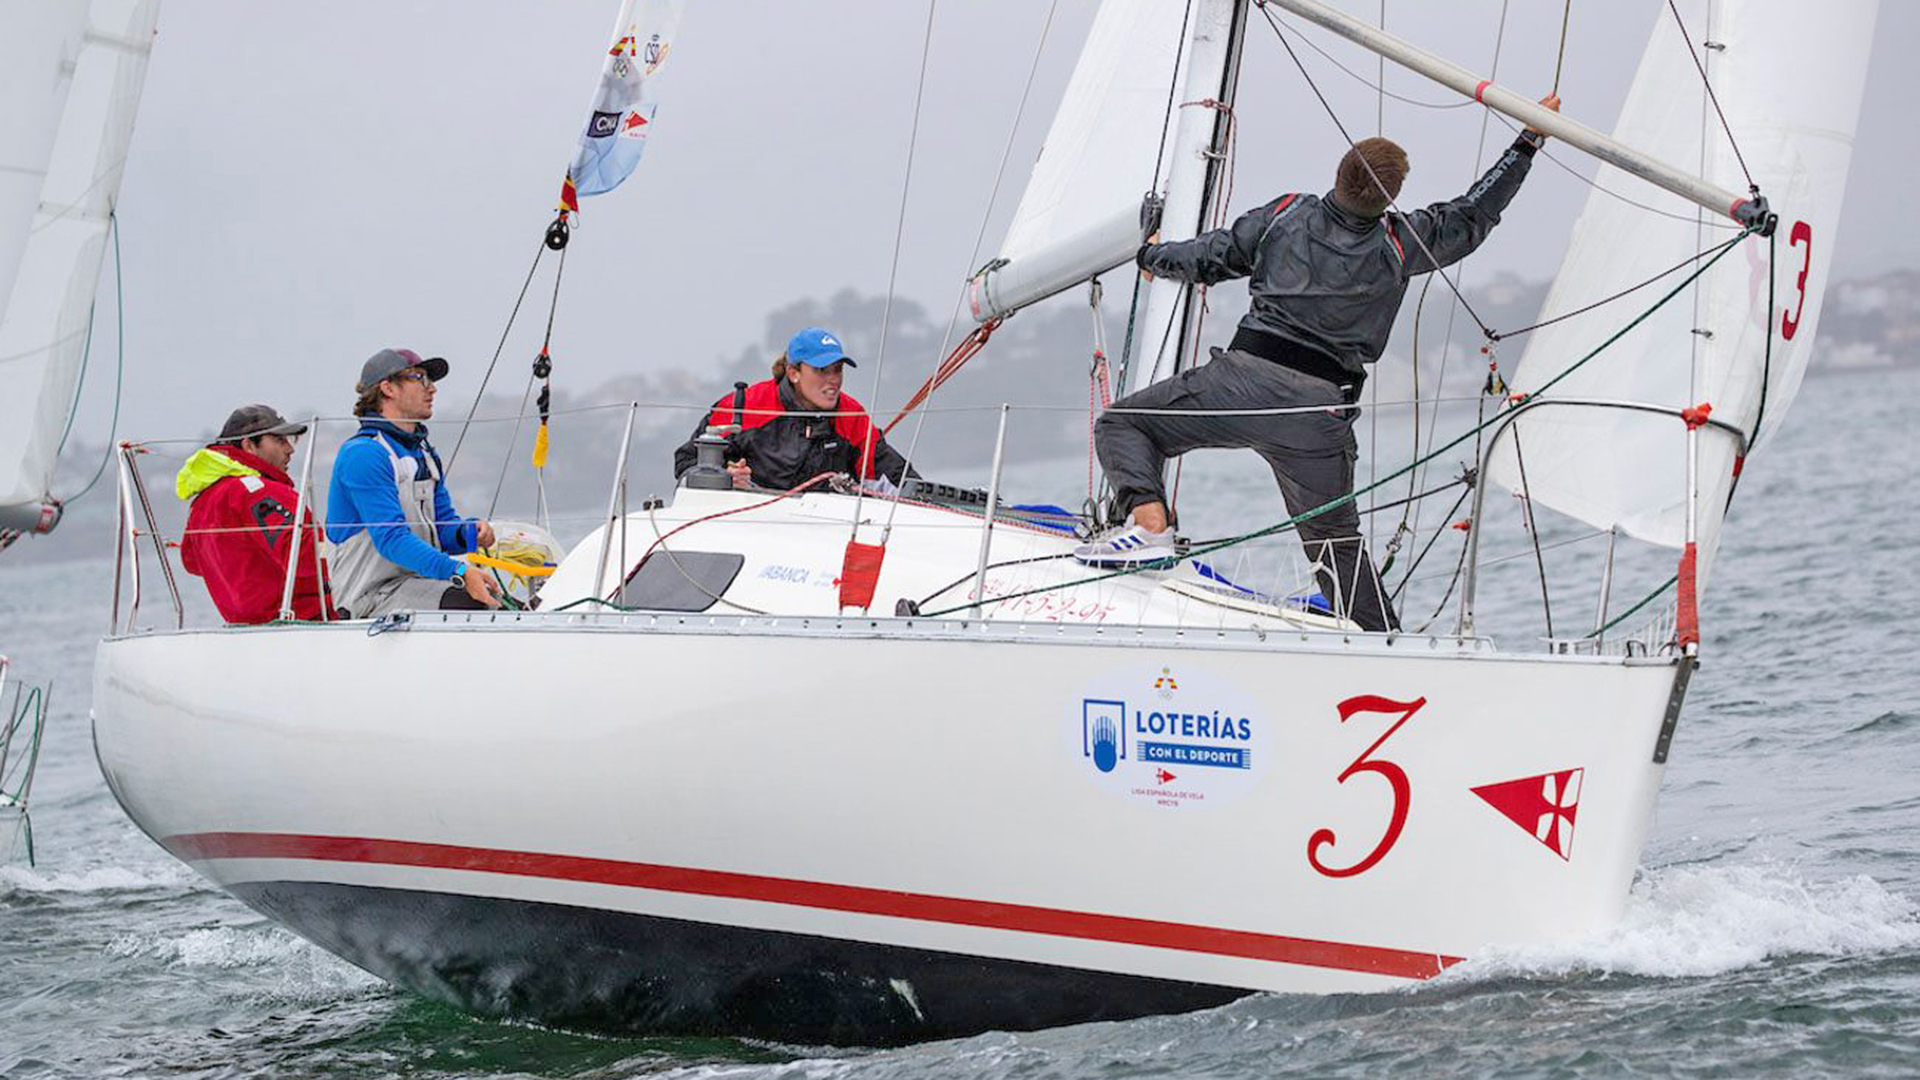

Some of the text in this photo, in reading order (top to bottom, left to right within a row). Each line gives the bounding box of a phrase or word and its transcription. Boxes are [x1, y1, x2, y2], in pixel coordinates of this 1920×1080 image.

[1466, 149, 1520, 203] ROOSTER
[1781, 220, 1812, 341] 3
[1136, 710, 1251, 741] LOTERÍAS
[1149, 747, 1239, 764] CON EL DEPORTE
[1307, 694, 1427, 878] 3
